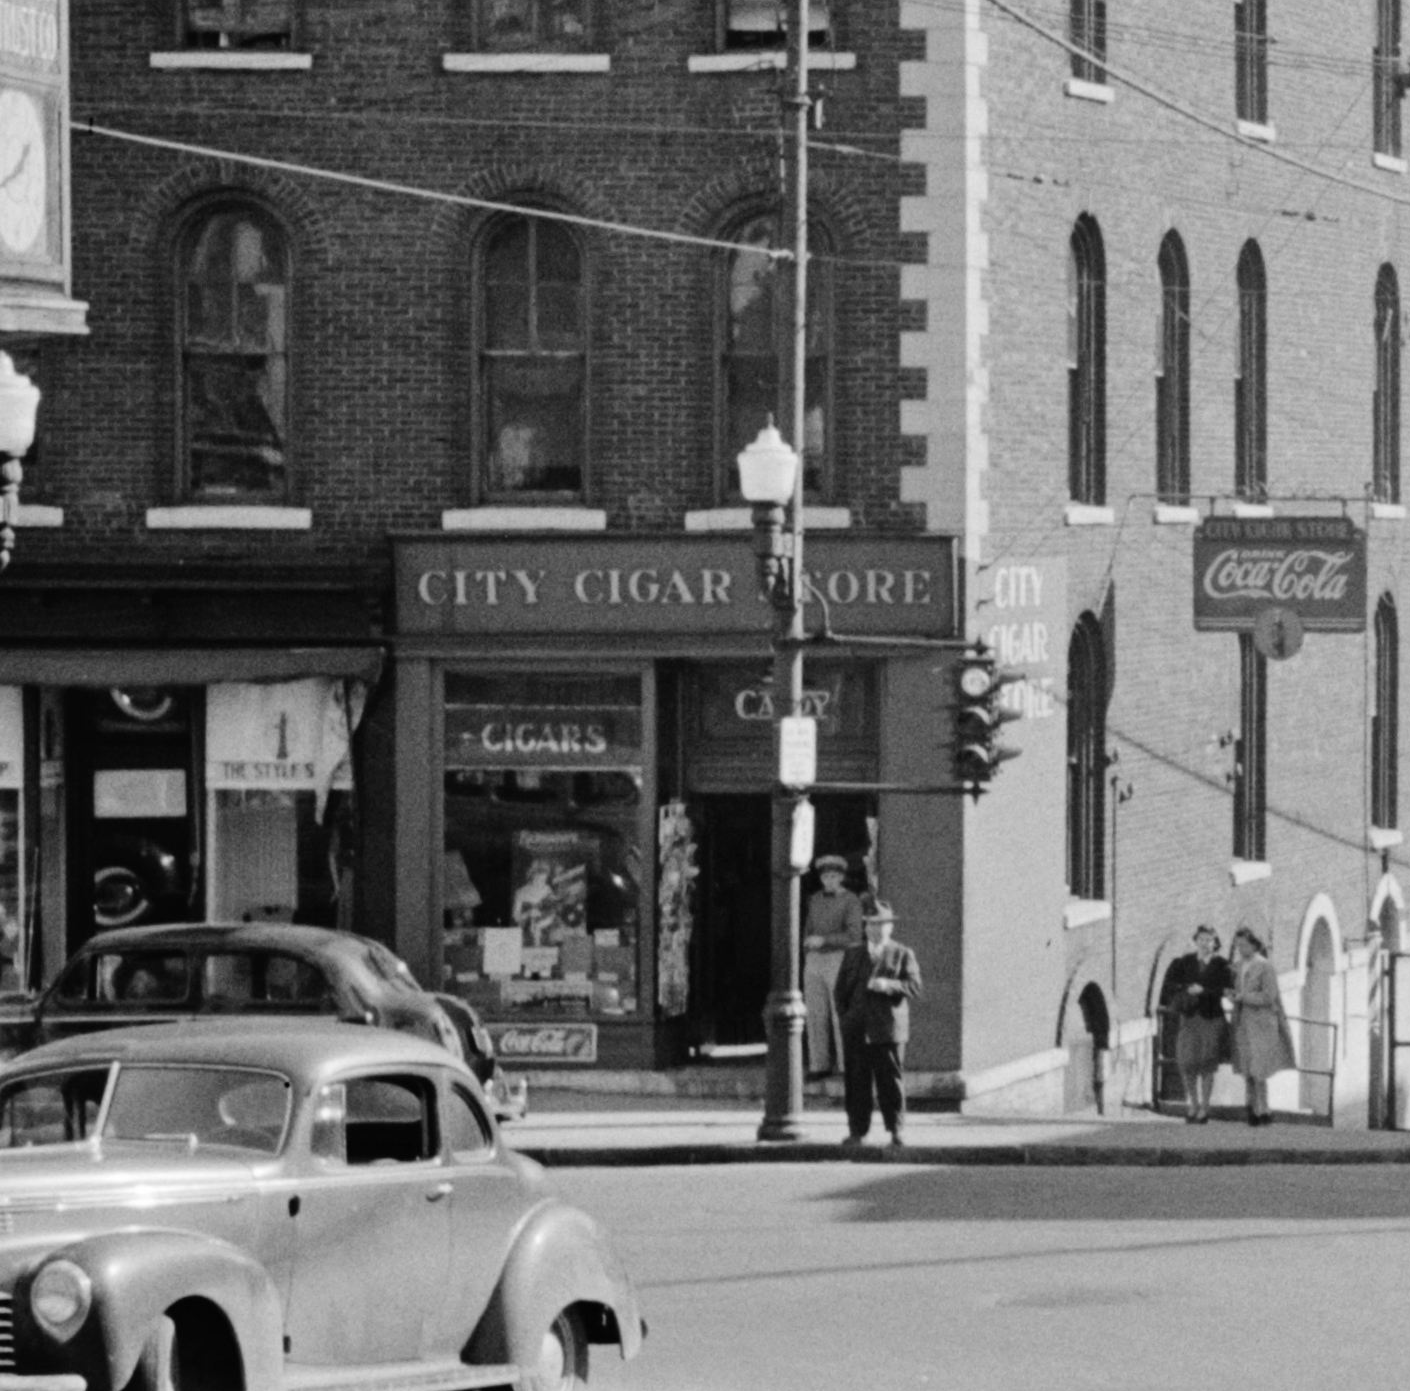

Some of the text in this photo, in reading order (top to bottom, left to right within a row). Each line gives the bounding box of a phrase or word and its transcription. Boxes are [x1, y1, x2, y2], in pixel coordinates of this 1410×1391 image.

[418, 568, 931, 605] CITY CIGAR TORE
[994, 565, 1043, 610] CITY
[1203, 548, 1354, 600] Coca-Cola
[988, 619, 1050, 666] CIGAR
[734, 689, 830, 719] CADY
[1000, 676, 1055, 720] TORE
[481, 722, 607, 753] CIGARS
